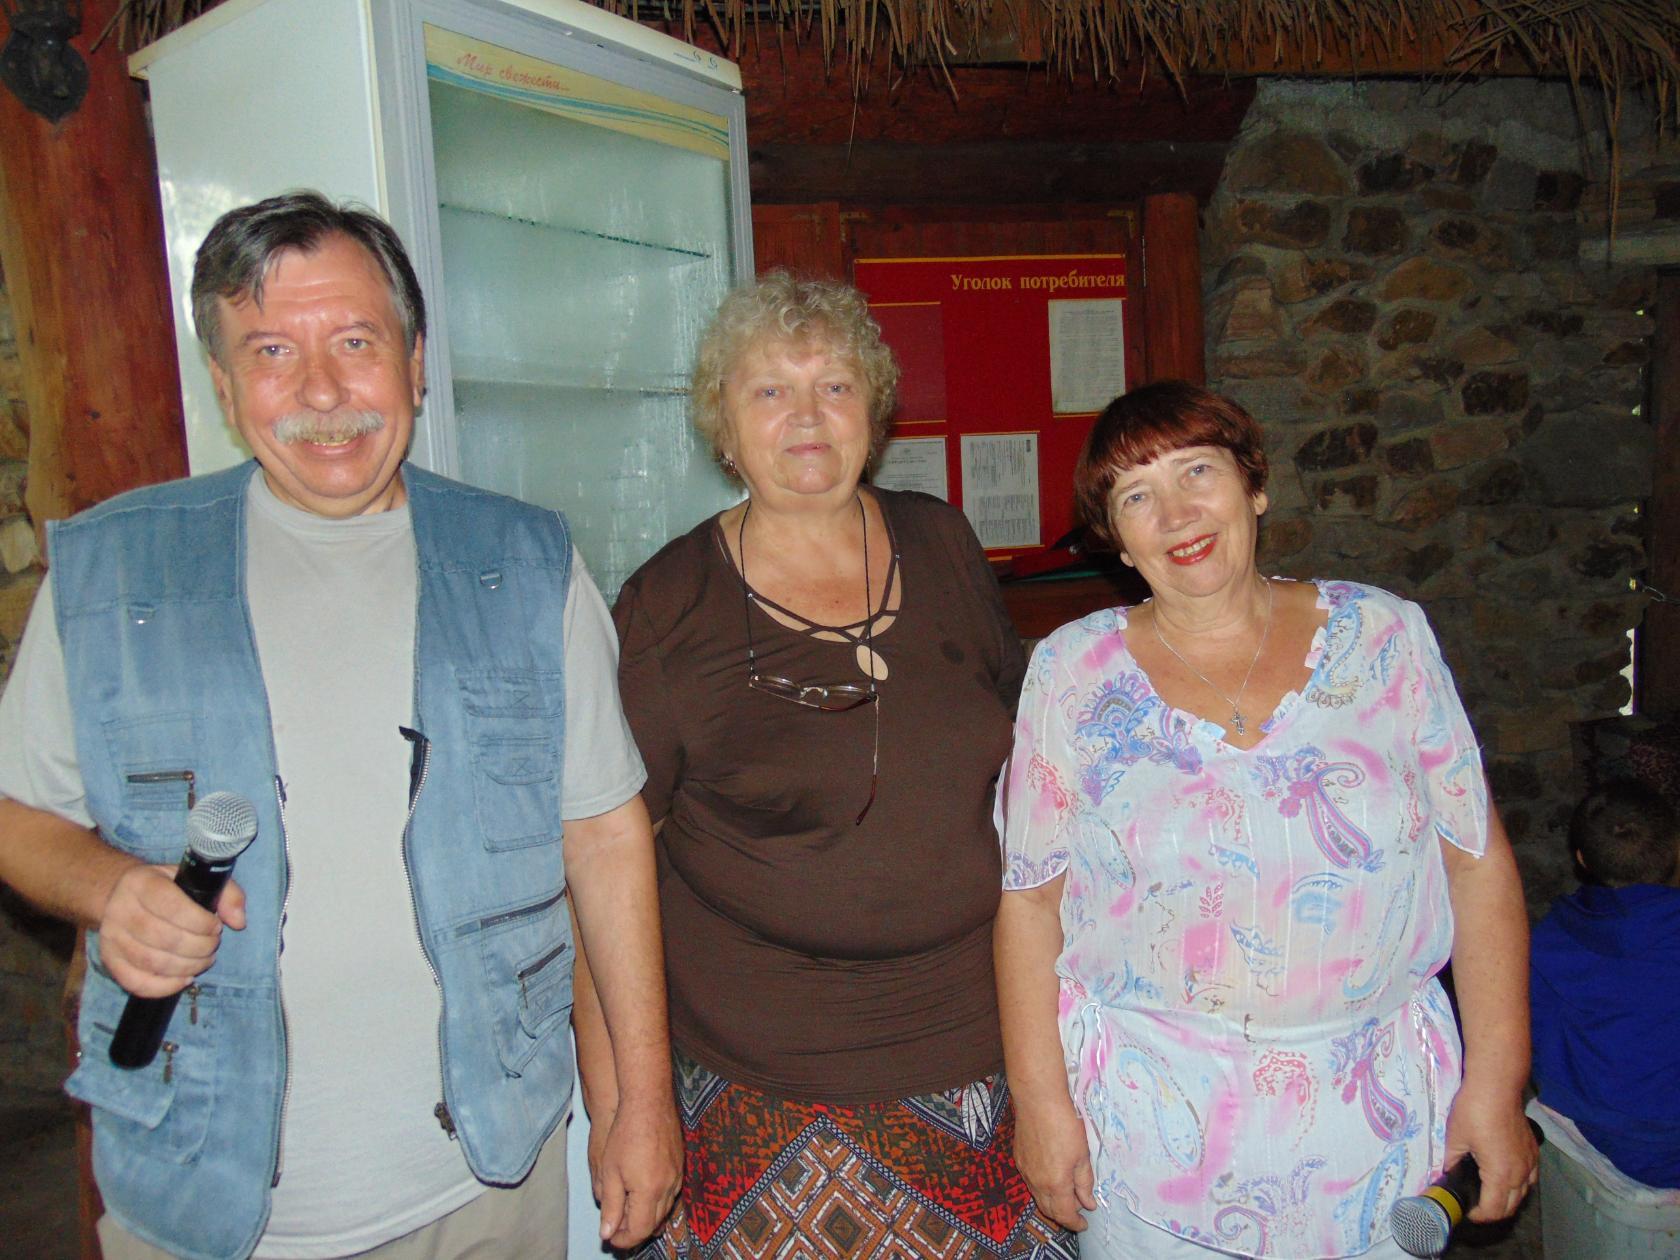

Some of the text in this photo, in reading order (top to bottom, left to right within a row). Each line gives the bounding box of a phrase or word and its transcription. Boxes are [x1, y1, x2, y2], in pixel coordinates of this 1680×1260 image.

[457, 53, 493, 76] Мир
[950, 269, 1125, 292] Уголок потребителя
